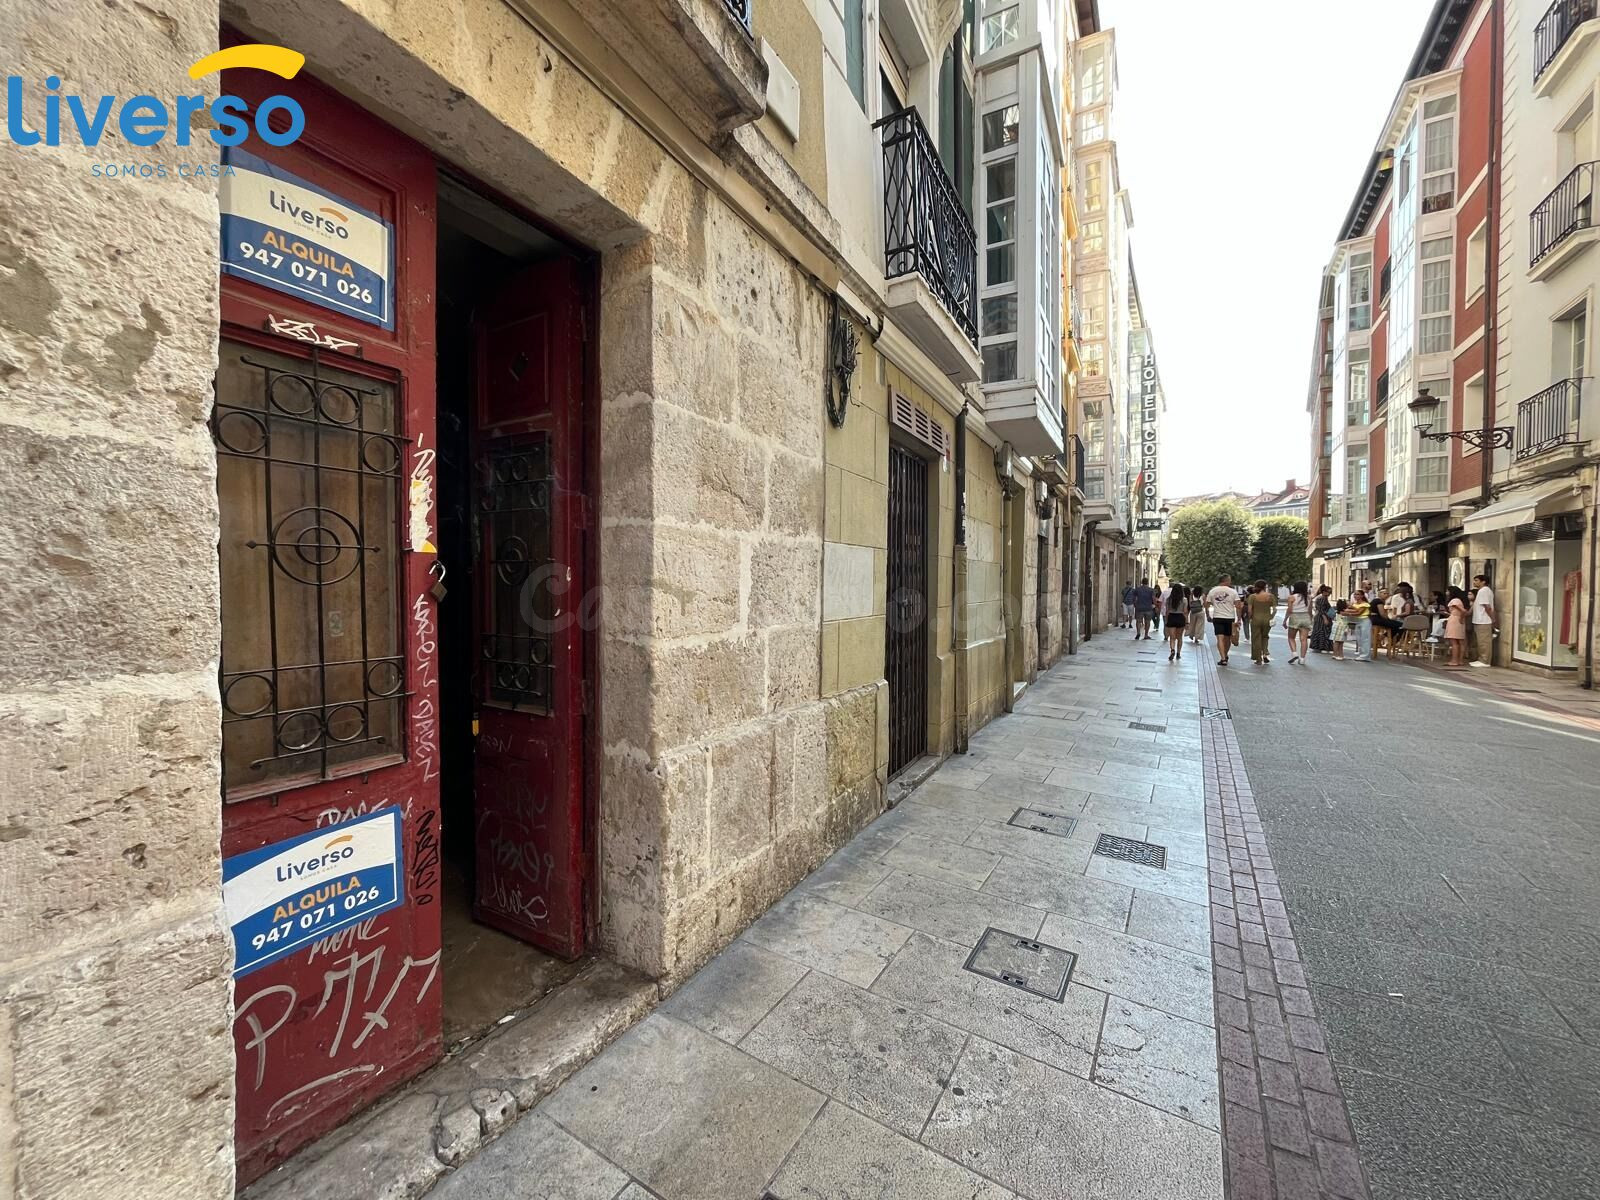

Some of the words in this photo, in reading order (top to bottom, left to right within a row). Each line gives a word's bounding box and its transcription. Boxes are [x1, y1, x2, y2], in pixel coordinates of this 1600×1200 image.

[239, 241, 284, 269] 947
[291, 261, 328, 288] 071
[336, 278, 373, 304] 026
[262, 230, 355, 279] ALQUILA
[1142, 353, 1156, 422] HOTEL
[1143, 429, 1156, 511] CORDON
[251, 920, 293, 951] 947
[300, 902, 336, 929] 071
[344, 885, 380, 911] 026
[272, 876, 361, 923] ALQUILA
